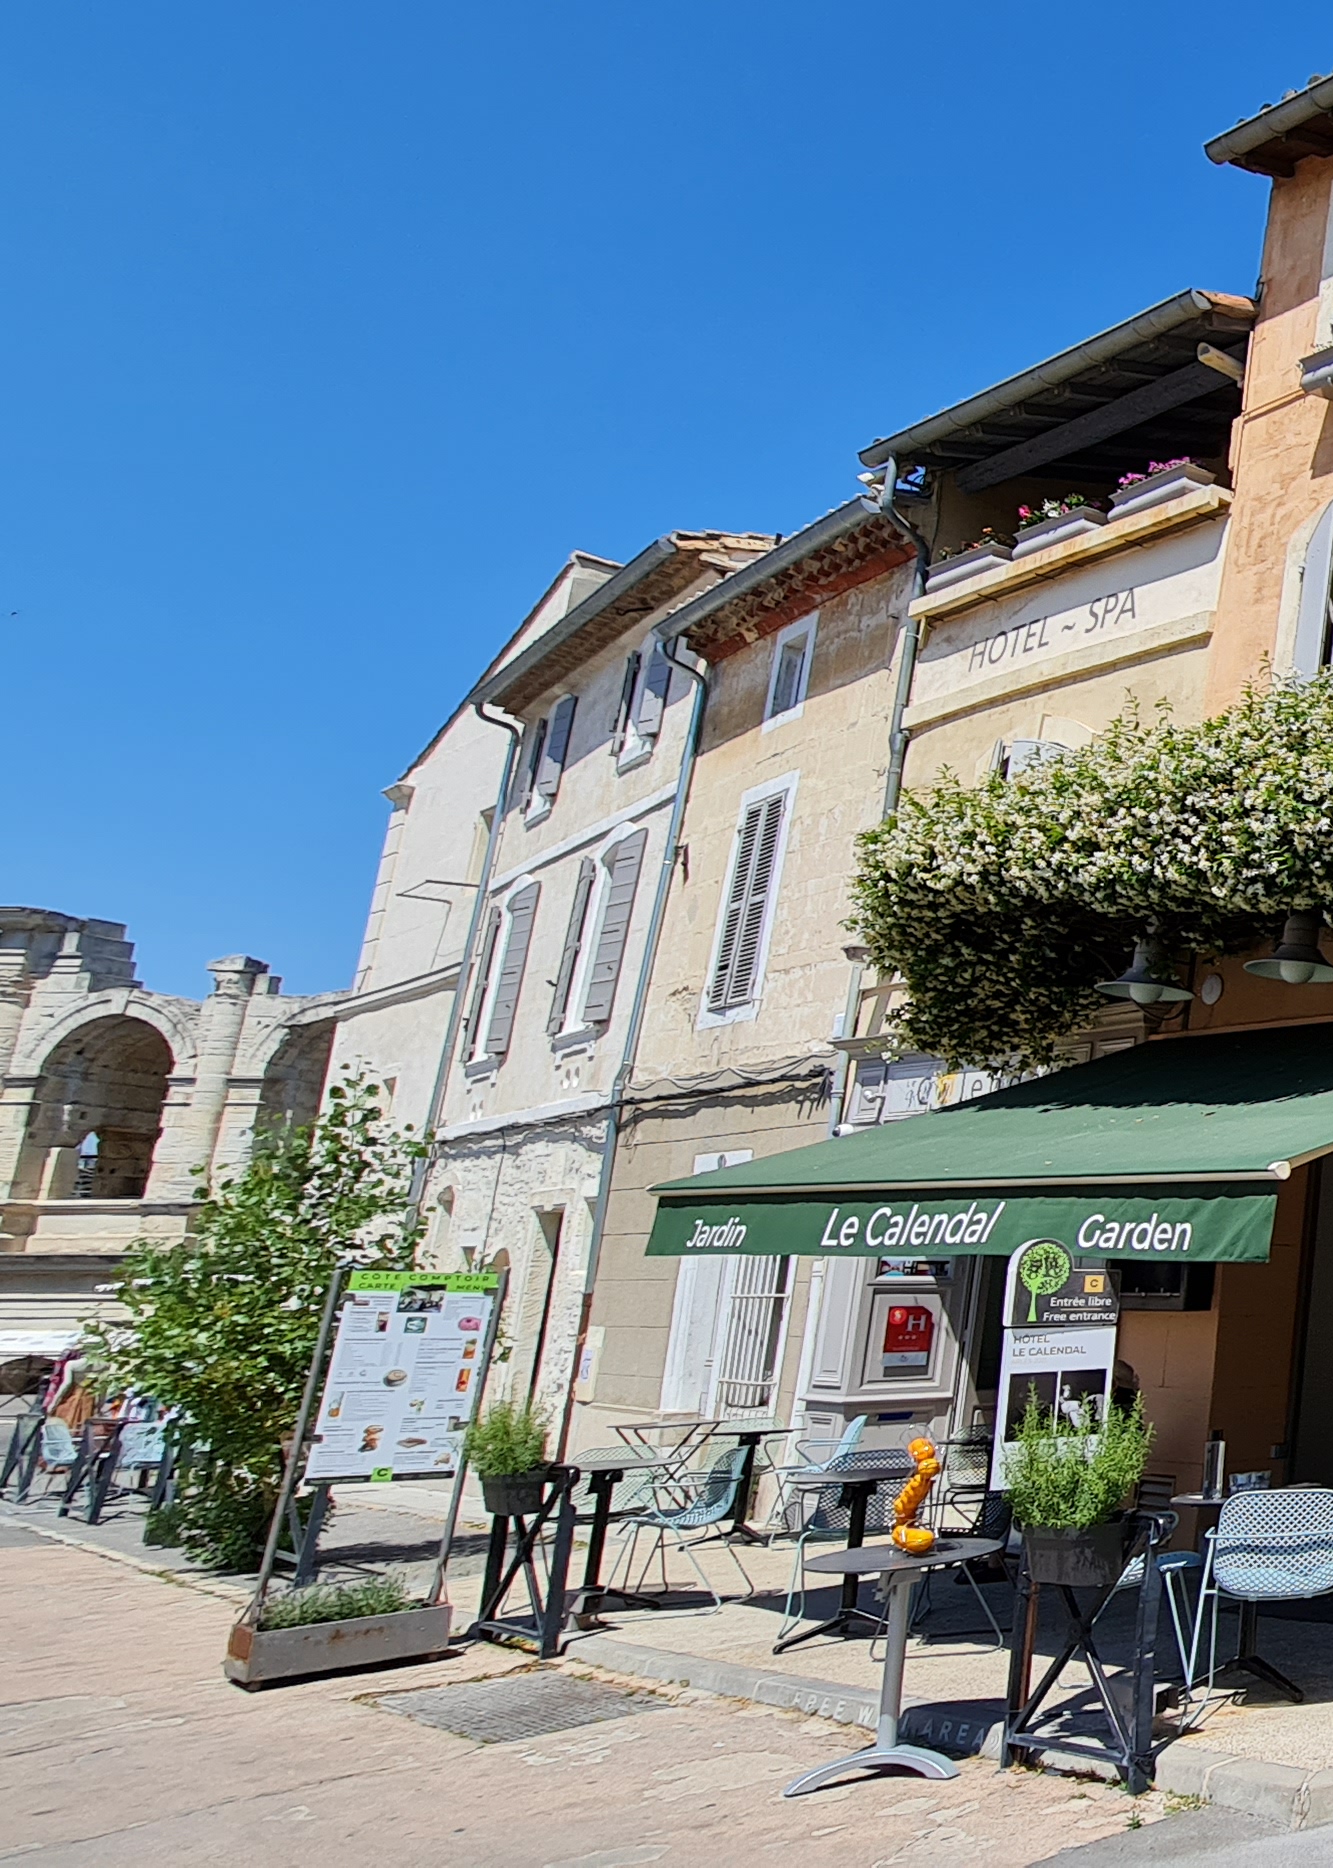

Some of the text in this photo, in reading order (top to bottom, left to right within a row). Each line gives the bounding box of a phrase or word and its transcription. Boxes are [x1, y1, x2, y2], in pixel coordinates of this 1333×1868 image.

[968, 616, 1049, 672] HOTEL
[1084, 587, 1136, 634] SPA
[686, 1201, 1193, 1252] Jardin Le Calendal Garden
[408, 1273, 490, 1282] COMPTOIR
[358, 1282, 396, 1290] CARTE
[1050, 1295, 1112, 1308] Entrée libre
[906, 1314, 927, 1332] H
[1043, 1311, 1116, 1322] Free entrance
[1012, 1345, 1087, 1357] LE CALENDAL
[920, 1720, 984, 1748] AREA
